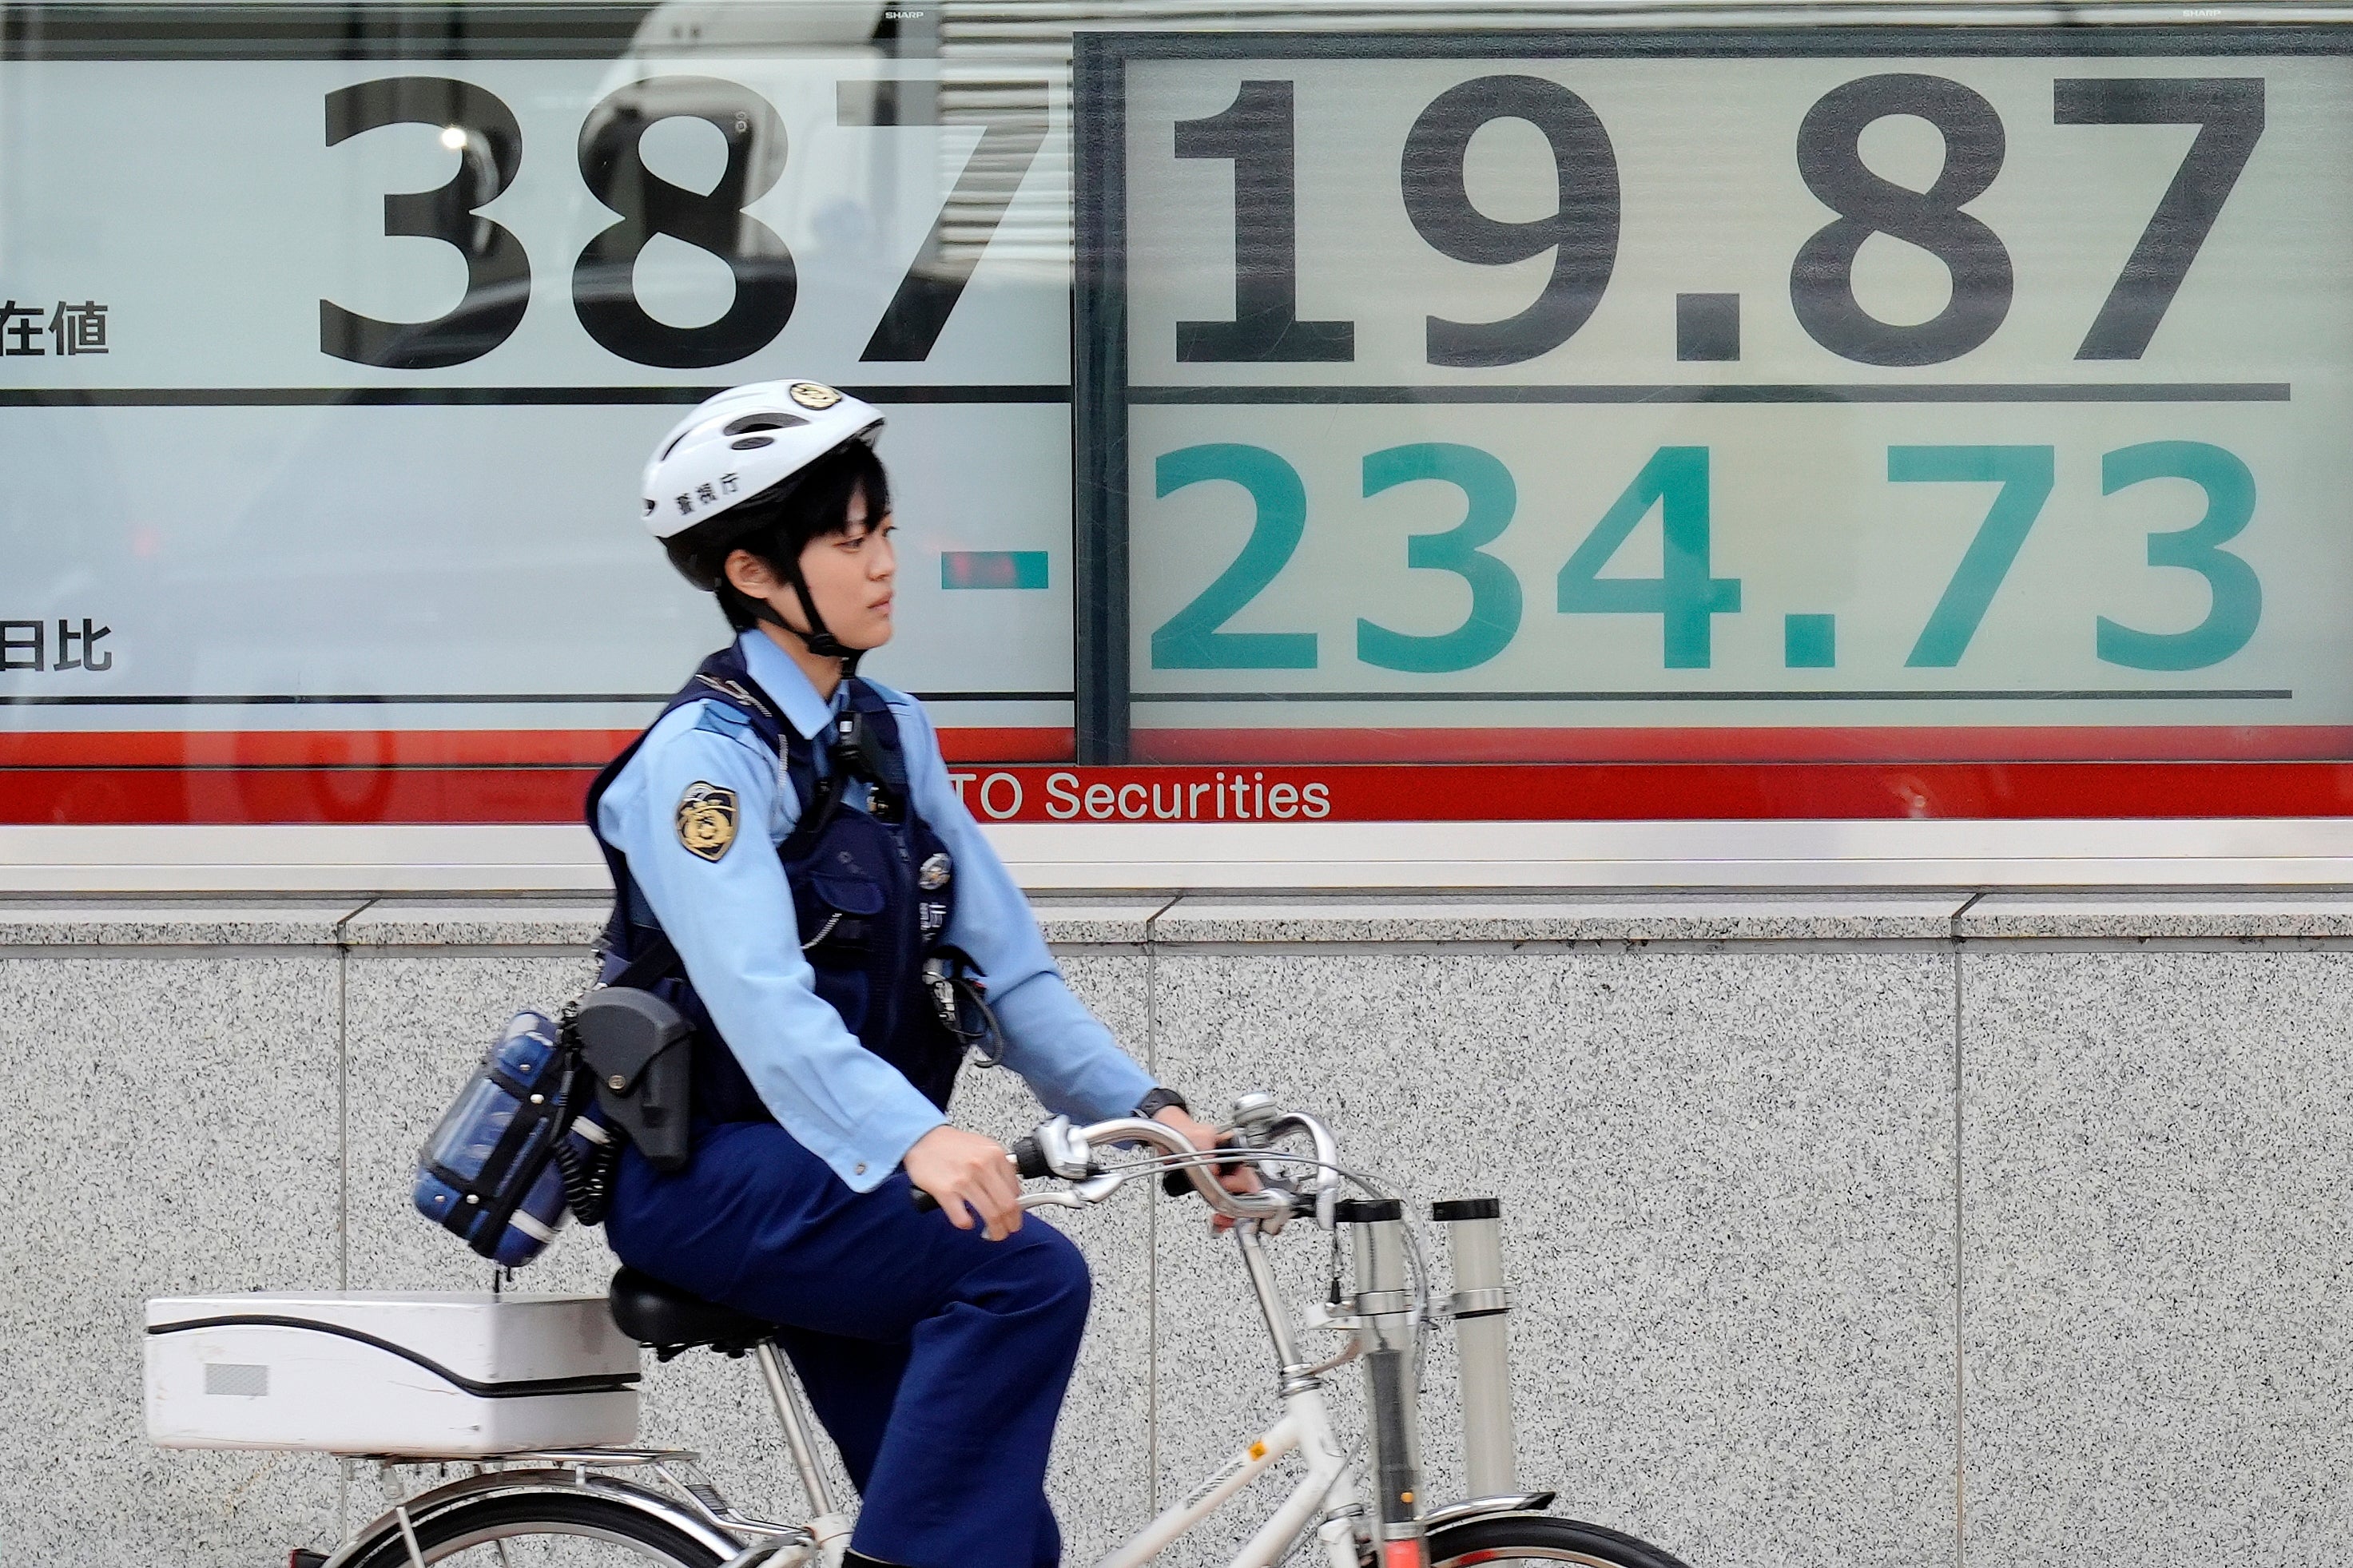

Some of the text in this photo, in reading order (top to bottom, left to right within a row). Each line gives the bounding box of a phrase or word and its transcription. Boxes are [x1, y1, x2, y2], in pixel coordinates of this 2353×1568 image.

[0, 300, 109, 357] 在値
[0, 618, 113, 673] 日比
[1045, 772, 1331, 820] Securities
